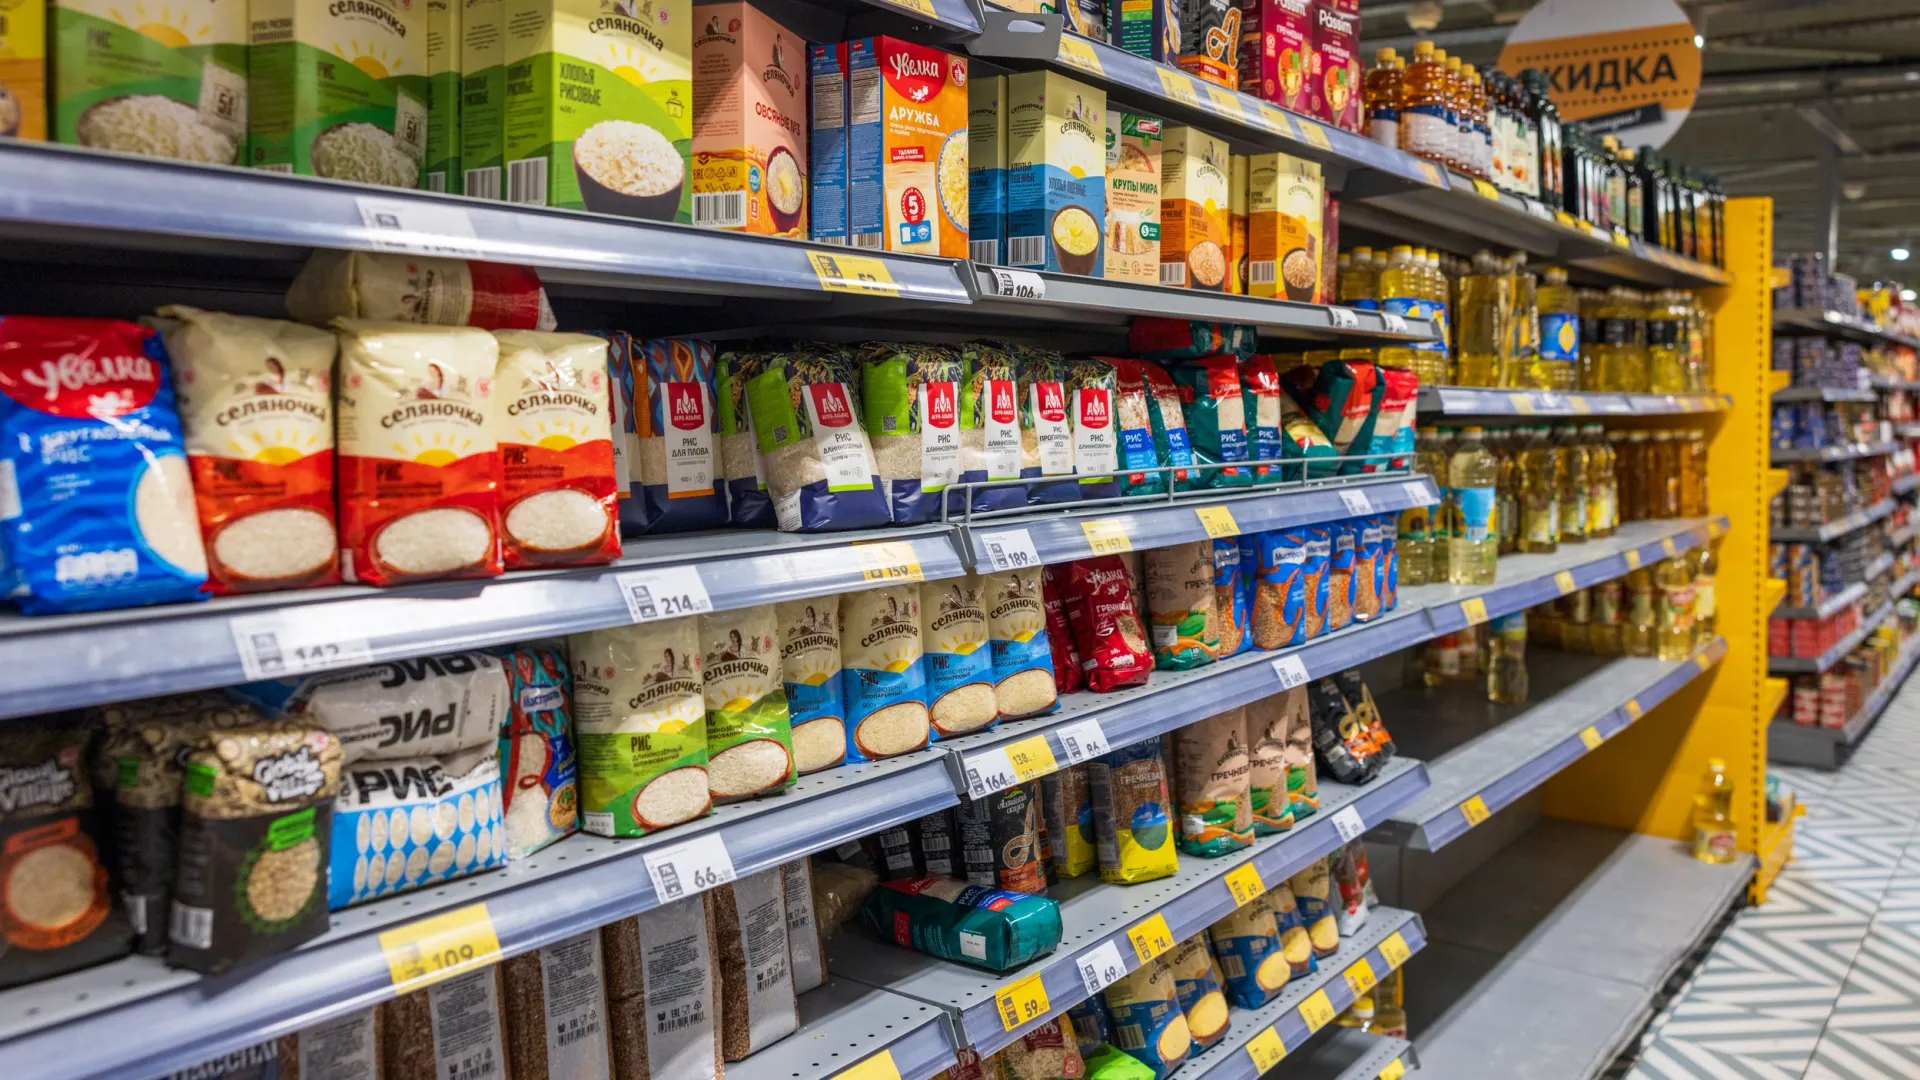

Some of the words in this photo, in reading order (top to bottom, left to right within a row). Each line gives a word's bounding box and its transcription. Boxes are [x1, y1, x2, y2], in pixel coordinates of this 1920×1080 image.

[560, 63, 595, 83] ХЛОПЬЯ
[1543, 52, 1677, 94] КИДКА
[560, 80, 602, 107] РИСОВЫЕ
[889, 104, 940, 128] ДРУЖБА
[1113, 179, 1139, 193] КРУПЫ
[1139, 181, 1158, 195] МИРА
[908, 195, 919, 215] 5
[834, 432, 852, 443] РИС
[937, 434, 951, 444] РИС
[1000, 429, 1013, 438] РИС
[1090, 434, 1104, 442] РИС
[1124, 433, 1142, 442] РИС
[1168, 432, 1182, 441] РИС
[1220, 433, 1237, 442] РИС
[1258, 430, 1273, 438] РИС
[682, 437, 698, 447] РИС
[671, 448, 687, 457] ДЛЯ
[687, 447, 709, 456] ПЛОВА
[1007, 551, 1028, 567] 189
[660, 594, 694, 614] 214
[861, 623, 919, 648] селяночка
[991, 642, 1009, 656] РИС
[932, 656, 950, 671] РИС
[703, 660, 769, 686] еляночка
[631, 735, 652, 753] РИС
[985, 772, 1008, 792] 164
[694, 865, 718, 888] 66
[432, 943, 474, 970] 109
[1103, 966, 1117, 983] 69
[1024, 999, 1038, 1018] 59
